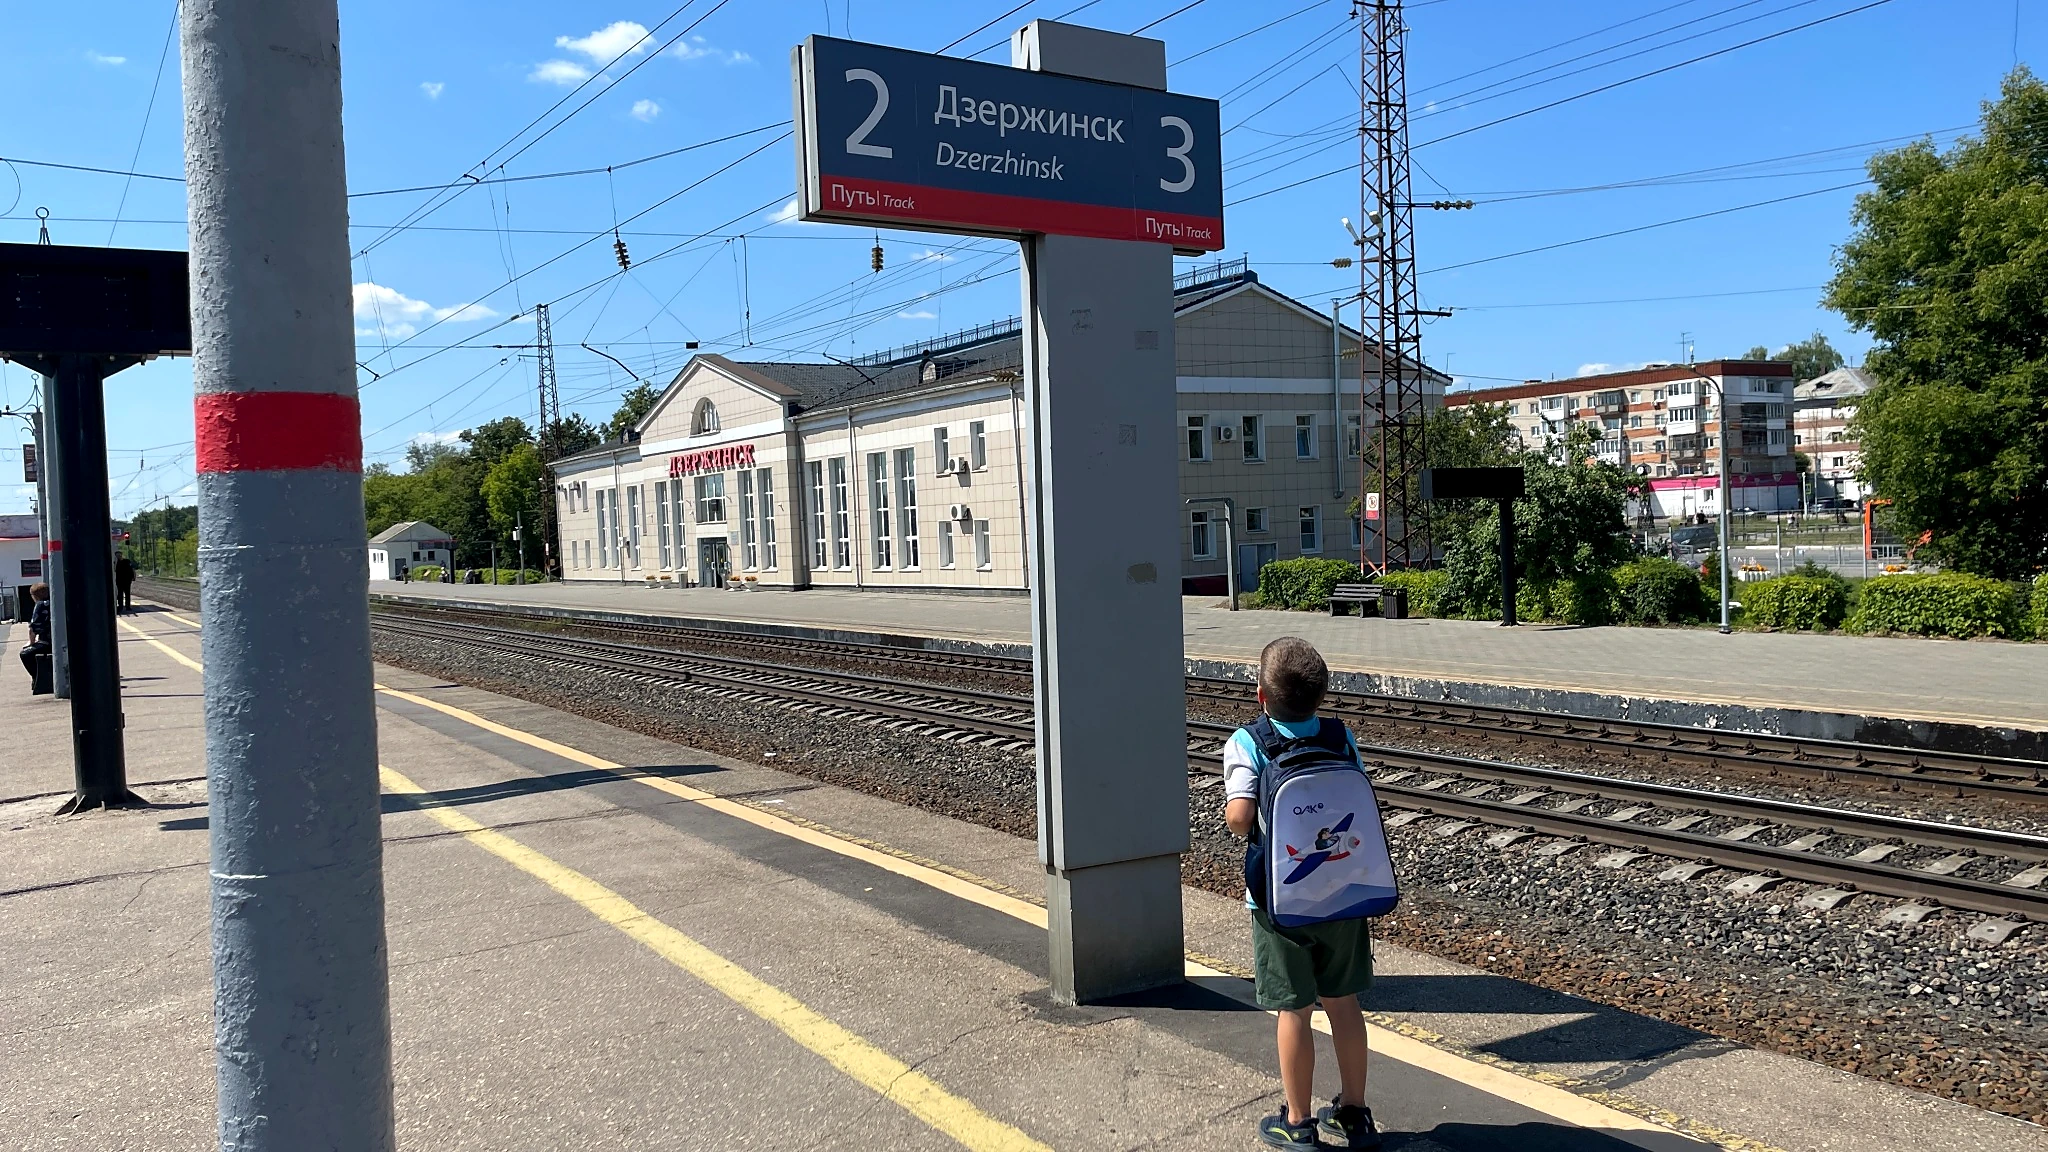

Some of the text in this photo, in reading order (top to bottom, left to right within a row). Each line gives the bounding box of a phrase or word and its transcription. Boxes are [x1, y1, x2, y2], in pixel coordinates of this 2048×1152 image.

[845, 68, 893, 159] 2
[934, 84, 1126, 144] Дзержинск
[936, 141, 1065, 181] Dzerzhinsk
[1160, 116, 1196, 193] 3
[883, 194, 915, 210] Track
[1185, 226, 1212, 240] Track
[668, 444, 756, 479] ДЗЕРЖИНСК
